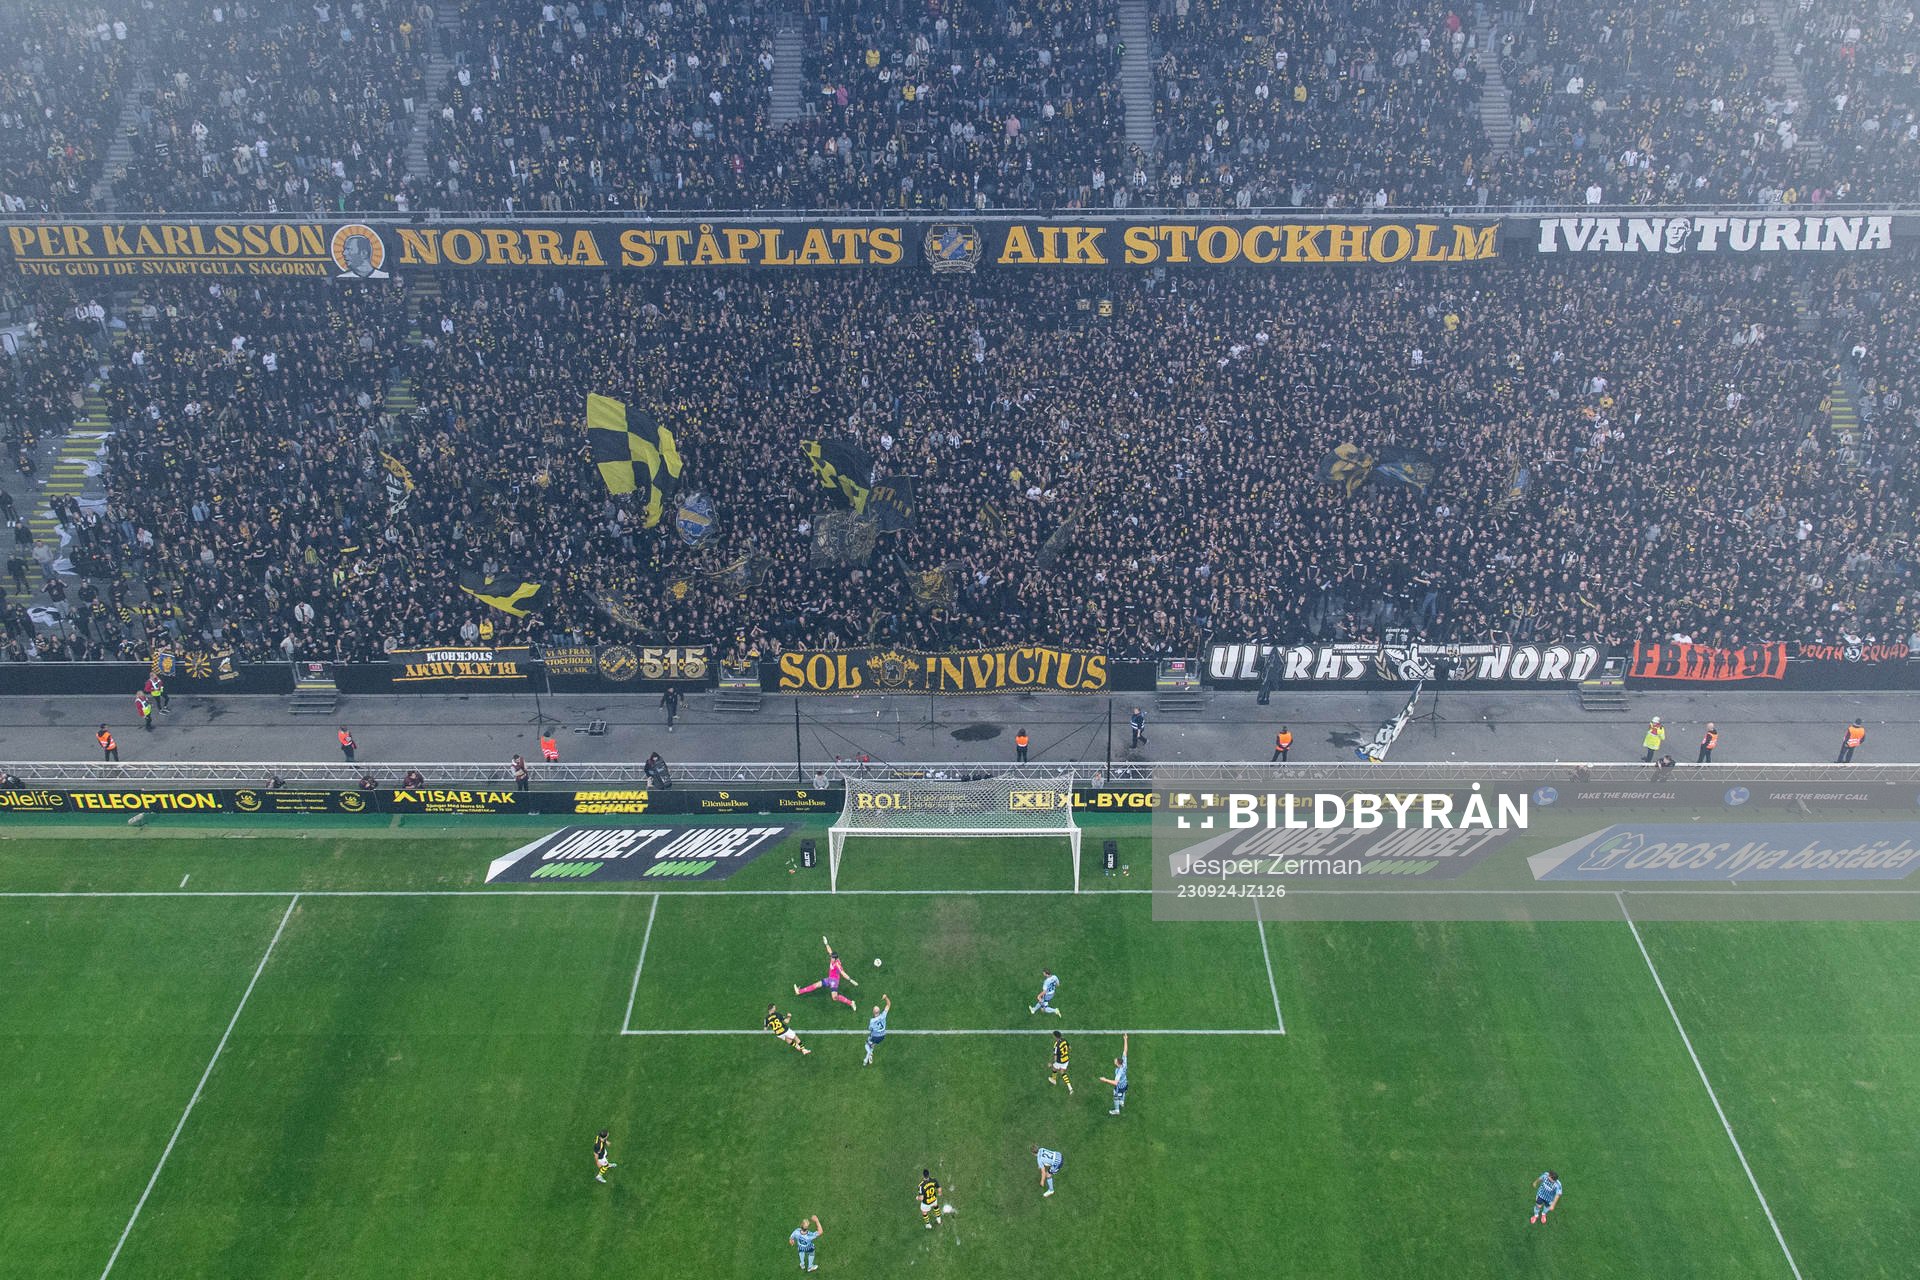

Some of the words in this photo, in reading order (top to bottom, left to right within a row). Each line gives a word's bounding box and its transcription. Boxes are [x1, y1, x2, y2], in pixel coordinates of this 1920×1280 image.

[8, 225, 94, 256] PER
[101, 224, 327, 256] KARLSSON
[998, 224, 1108, 264] AIK
[1124, 220, 1500, 264] STOCKHOLM
[1538, 217, 1666, 253] IVAN
[1693, 216, 1893, 251] TURINA
[396, 228, 607, 267] NORRA
[621, 223, 904, 267] STÅPLATS
[19, 262, 61, 276] EVIG
[65, 262, 99, 276] GUD
[103, 262, 110, 275] I
[114, 262, 138, 275] DE
[249, 261, 328, 276] SAGORNA
[426, 651, 493, 662] STOCKHOLM
[1799, 644, 1845, 660] YOUTH
[1861, 643, 1909, 661] SQUAD
[404, 662, 456, 677] ARMY
[460, 661, 518, 675] BLACK
[643, 647, 705, 679] 515
[1478, 643, 1600, 681] NORD
[779, 652, 862, 690] SOL
[416, 790, 473, 803] TISAB
[476, 791, 516, 804] TAK
[574, 791, 648, 801] BRUNNA
[1013, 792, 1053, 807] XL
[1058, 793, 1161, 807] XL-BYGG
[1577, 792, 1600, 800] TAKE
[1602, 792, 1619, 800] THE
[1621, 792, 1650, 800] RIGHT
[1651, 792, 1675, 800] CALL
[1843, 793, 1868, 801] CALL
[574, 803, 648, 813] SCHAKT
[1625, 843, 1730, 870] OBOS
[1718, 841, 1790, 878] Nya
